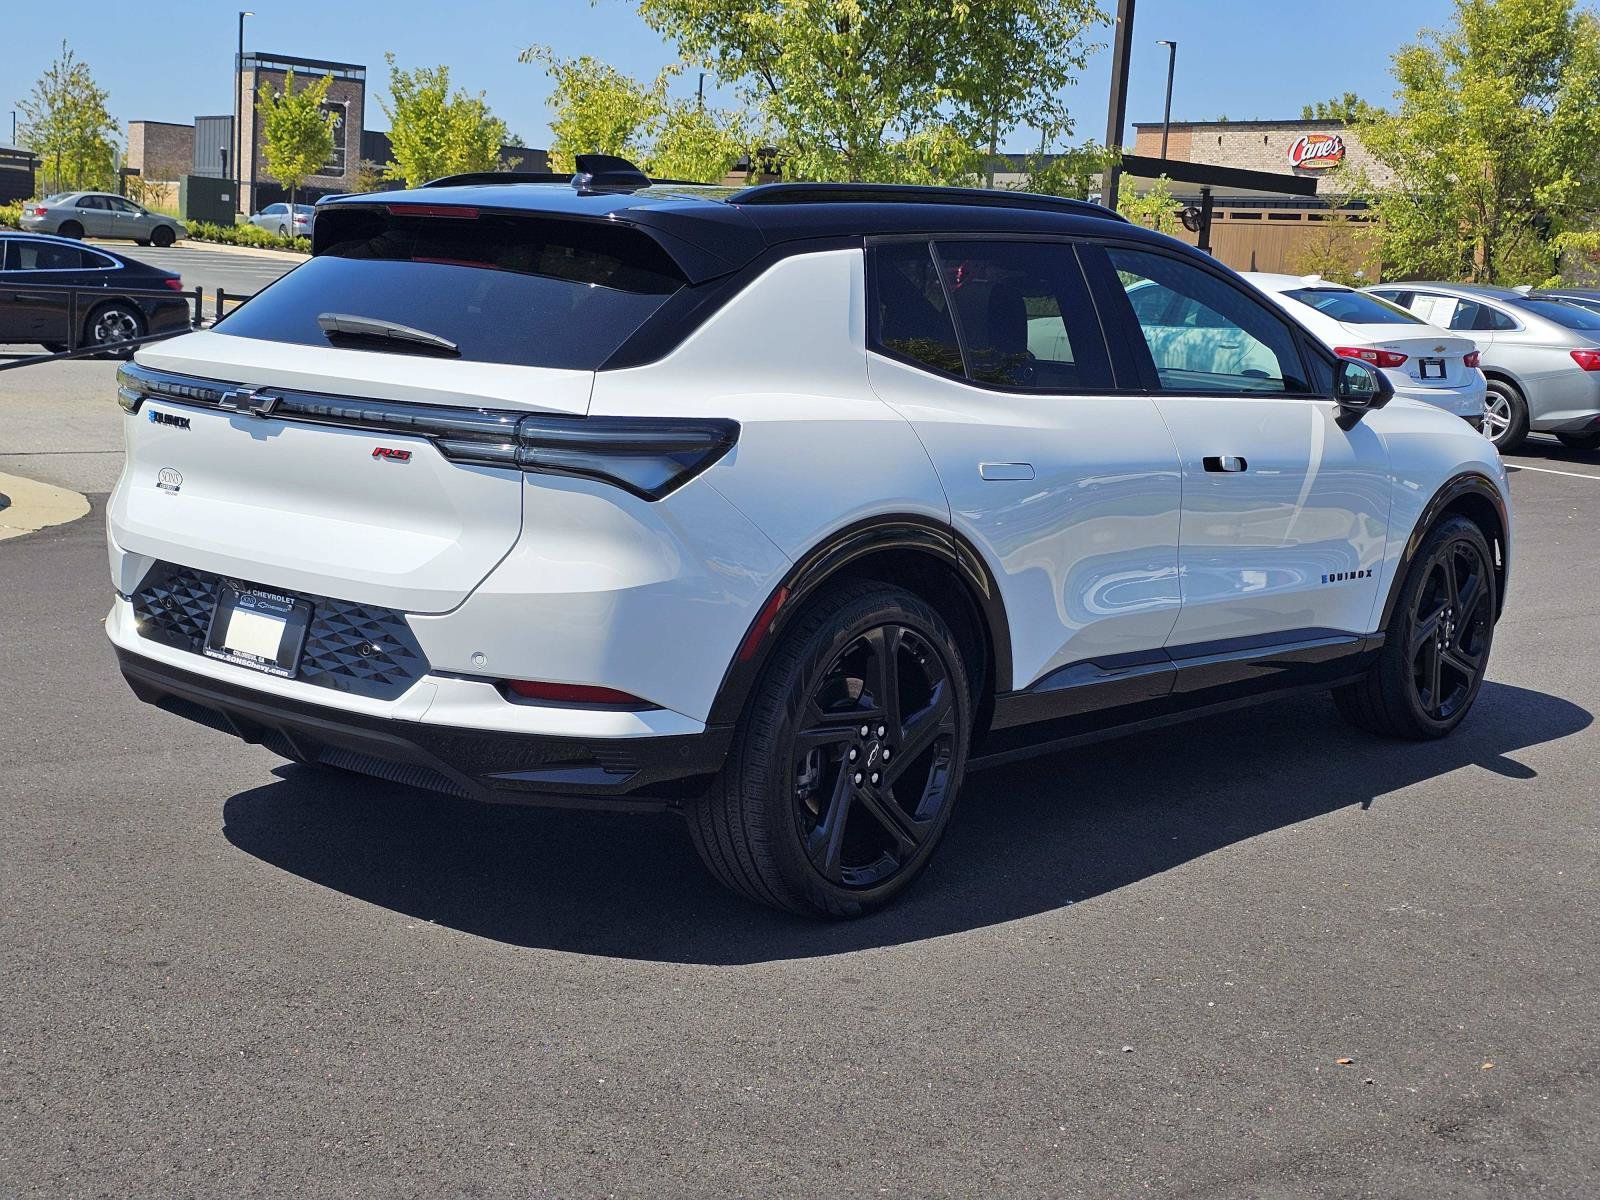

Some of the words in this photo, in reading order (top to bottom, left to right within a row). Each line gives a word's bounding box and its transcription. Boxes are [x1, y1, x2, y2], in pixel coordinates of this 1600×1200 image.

[372, 447, 412, 460] RS
[1321, 569, 1372, 584] EQUINOX
[252, 589, 295, 604] CHEVROLET
